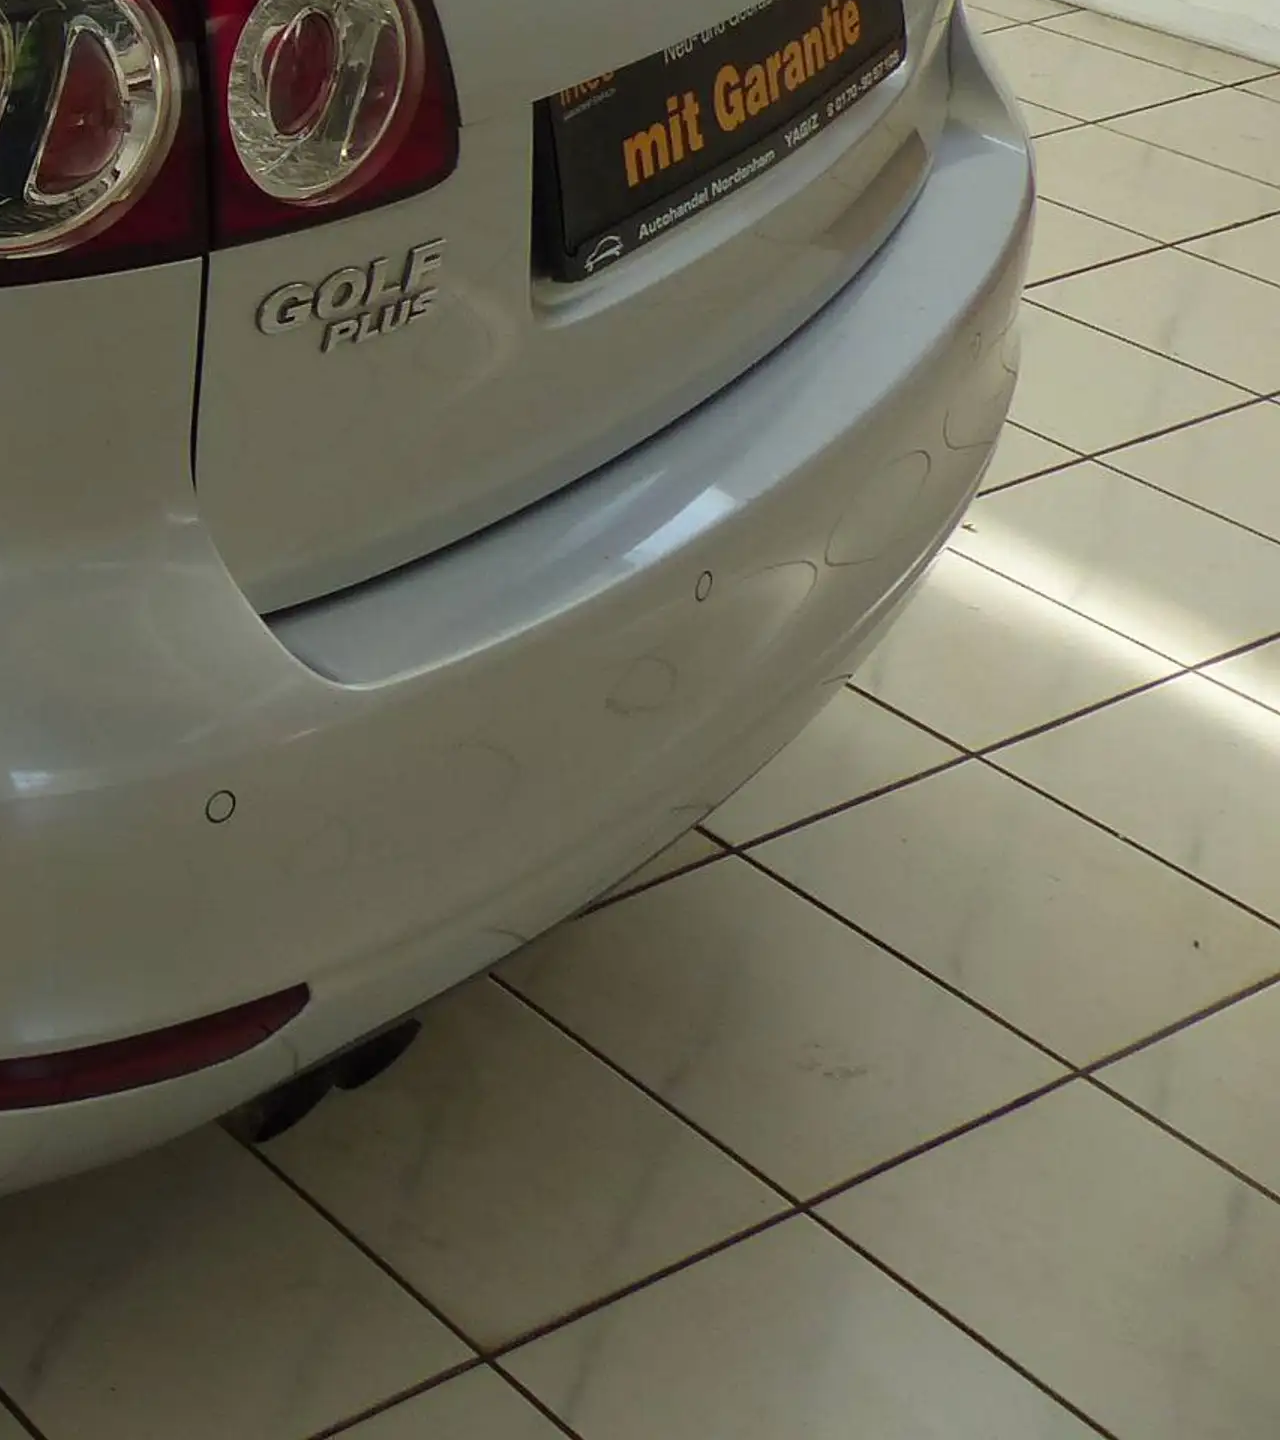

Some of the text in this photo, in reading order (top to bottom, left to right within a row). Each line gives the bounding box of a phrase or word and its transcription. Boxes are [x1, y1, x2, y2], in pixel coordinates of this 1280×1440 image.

[622, 88, 704, 189] mit
[638, 186, 709, 241] Autohandel
[711, 148, 777, 197] Nordenham
[256, 237, 448, 335] GOLF
[320, 286, 439, 353] PLUS
